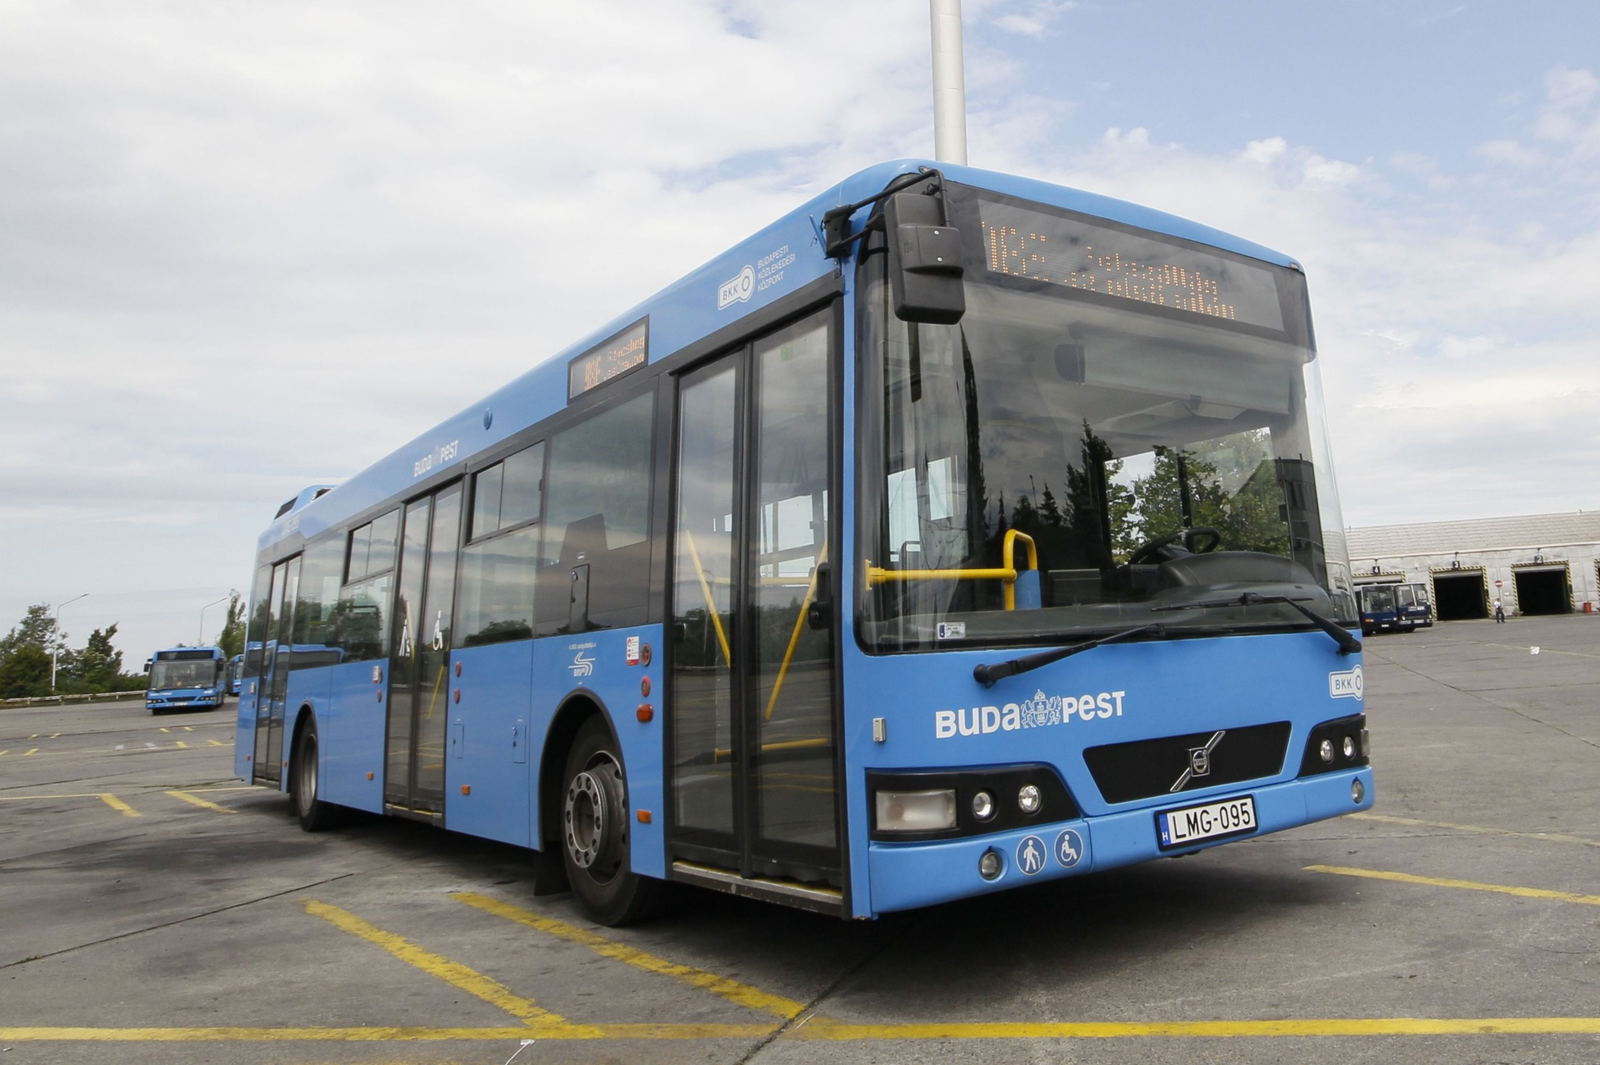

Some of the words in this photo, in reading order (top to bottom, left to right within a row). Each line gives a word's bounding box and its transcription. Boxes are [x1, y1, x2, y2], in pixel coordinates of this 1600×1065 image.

[1335, 678, 1352, 690] BKK
[1172, 802, 1251, 839] LMG-095
[1161, 831, 1168, 842] H
